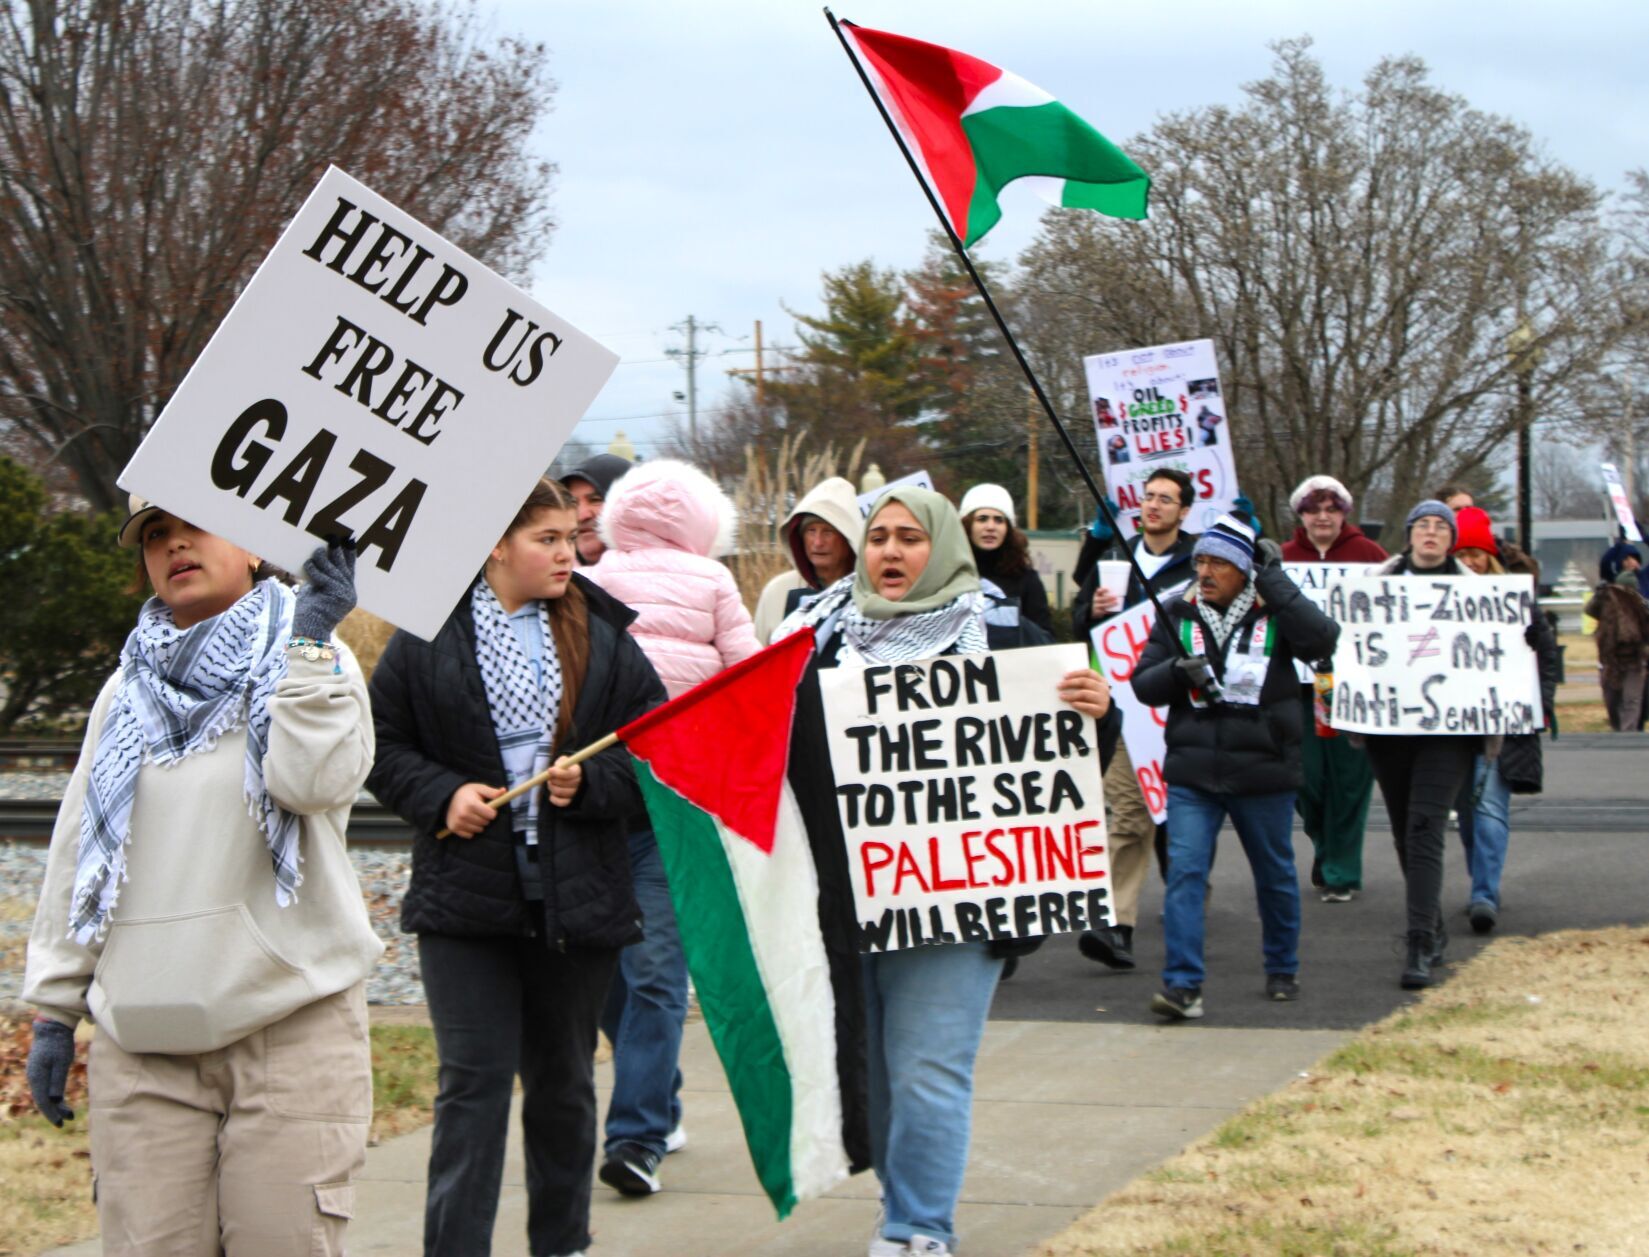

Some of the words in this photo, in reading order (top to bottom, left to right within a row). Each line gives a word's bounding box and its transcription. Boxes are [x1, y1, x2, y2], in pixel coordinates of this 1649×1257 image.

[302, 196, 468, 326] HELP
[482, 308, 563, 387] US
[301, 315, 464, 446] FREE
[1129, 399, 1175, 417] GREED
[1134, 387, 1164, 402] OIL
[1123, 413, 1182, 434] PROFITS
[1136, 427, 1194, 453] LIES!
[210, 398, 428, 573] GAZA
[1354, 632, 1389, 667] is
[864, 655, 1000, 714] FROM
[845, 718, 948, 774] THE
[955, 710, 1089, 767] RIVER
[837, 783, 895, 828] TO
[898, 775, 981, 825] THE
[992, 770, 1084, 817] SEA
[860, 820, 1105, 897] PALESTINE
[858, 904, 955, 953] WILL
[955, 897, 1012, 942] BE
[1014, 888, 1110, 936] FREE
